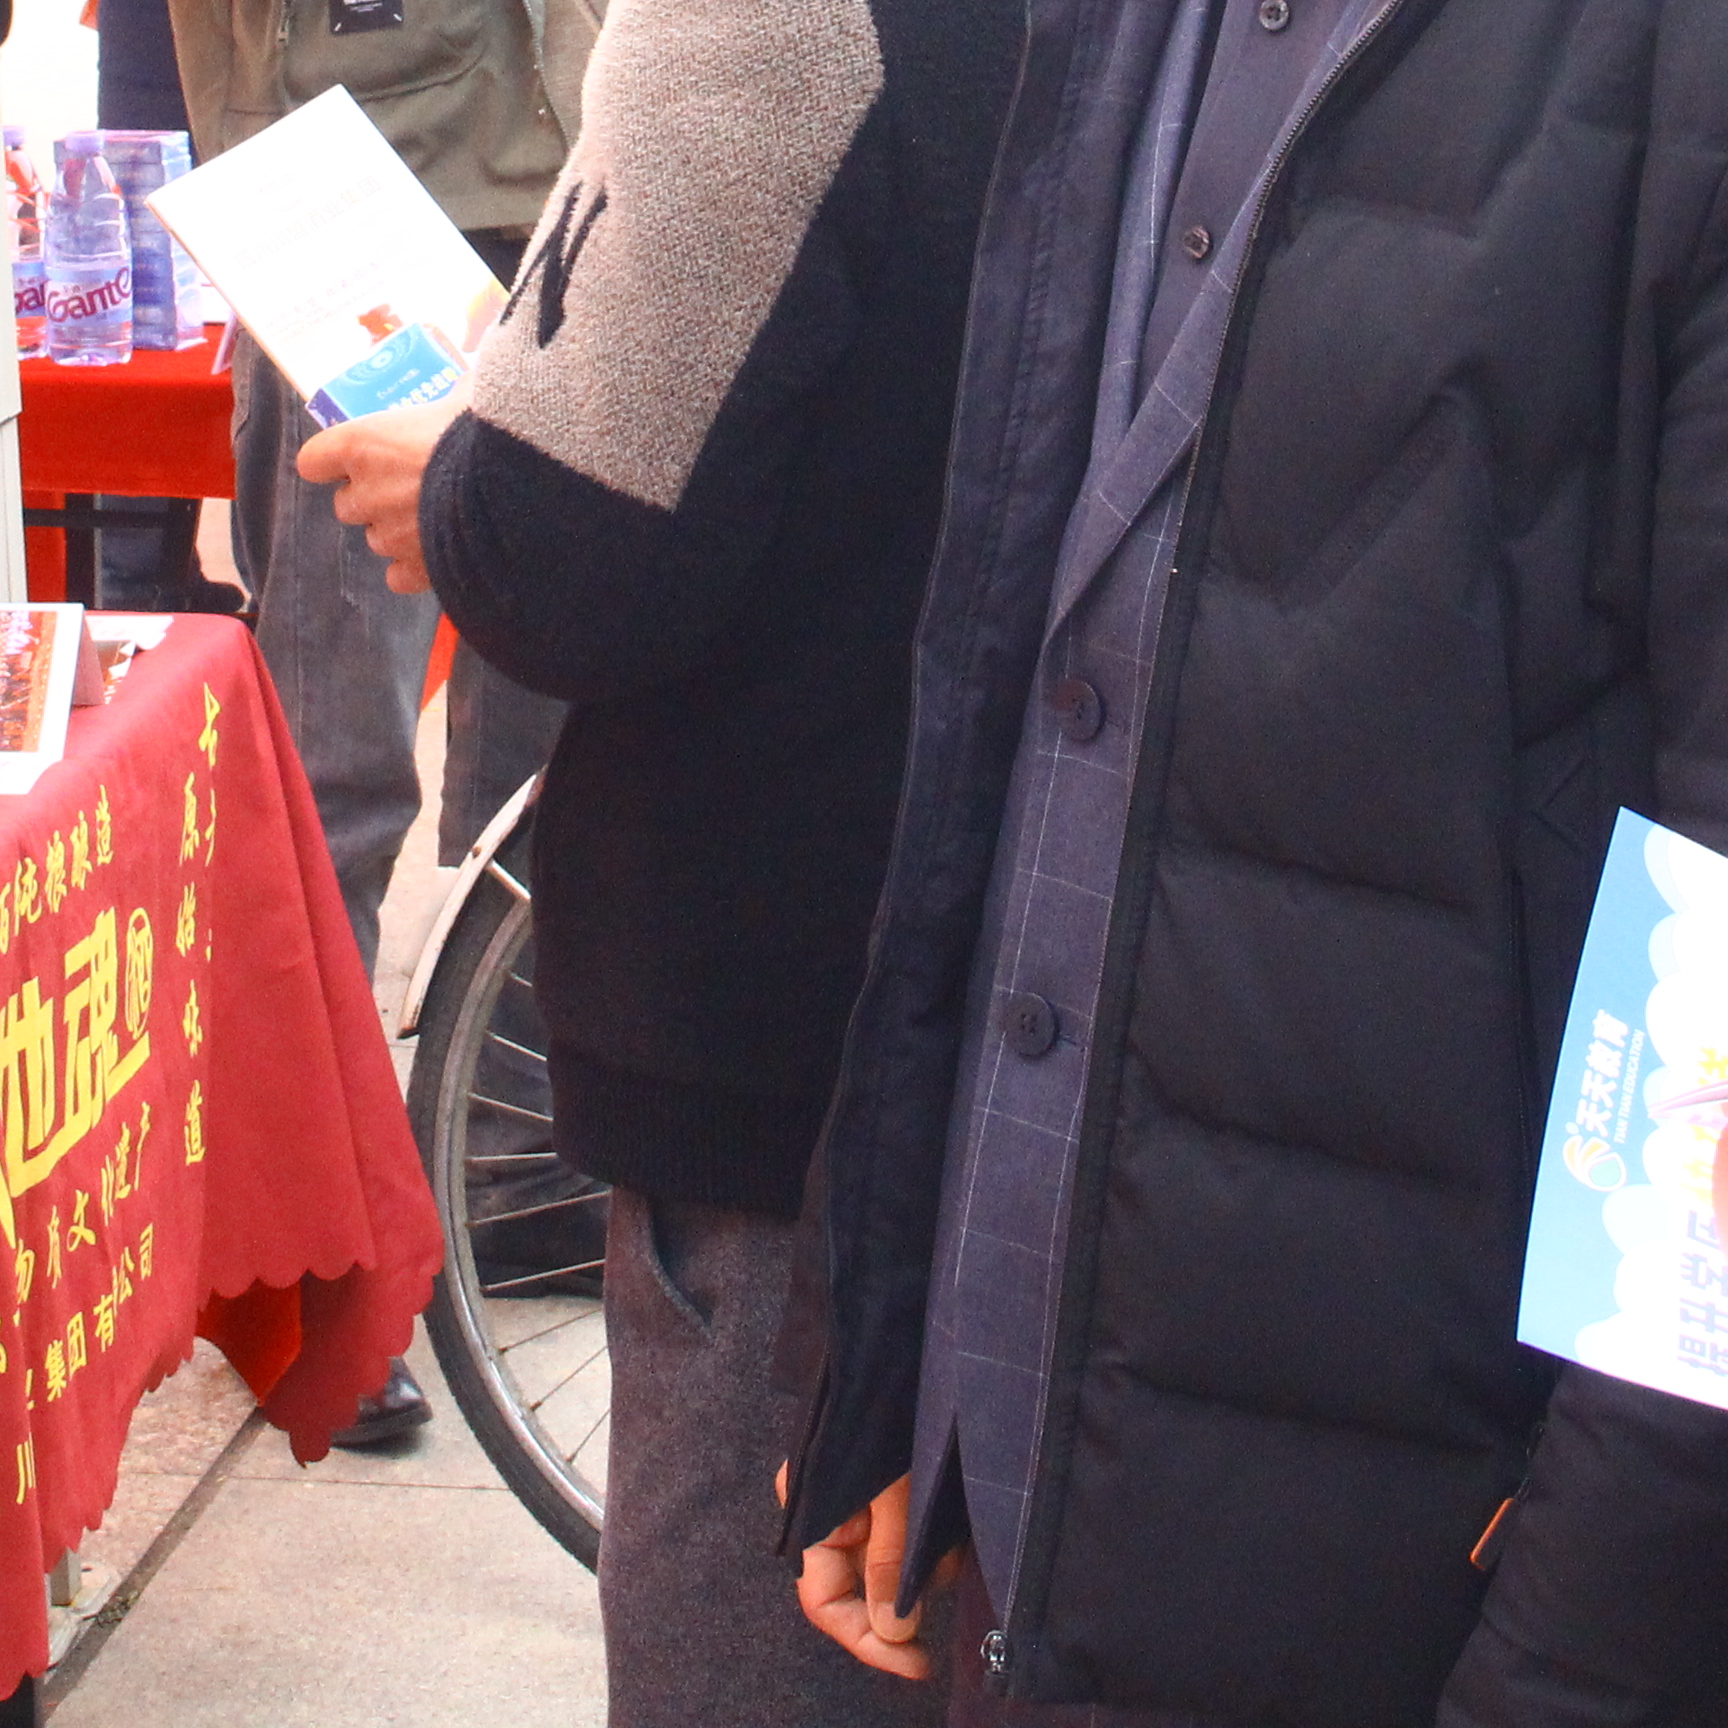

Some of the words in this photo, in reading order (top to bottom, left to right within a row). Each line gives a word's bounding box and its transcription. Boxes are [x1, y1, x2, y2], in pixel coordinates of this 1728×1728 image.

[1574, 1008, 1630, 1139] 天天教育
[1622, 1028, 1645, 1098] EDUCATION
[1613, 1120, 1628, 1144] TIAN
[1618, 1098, 1632, 1121] TIAN
